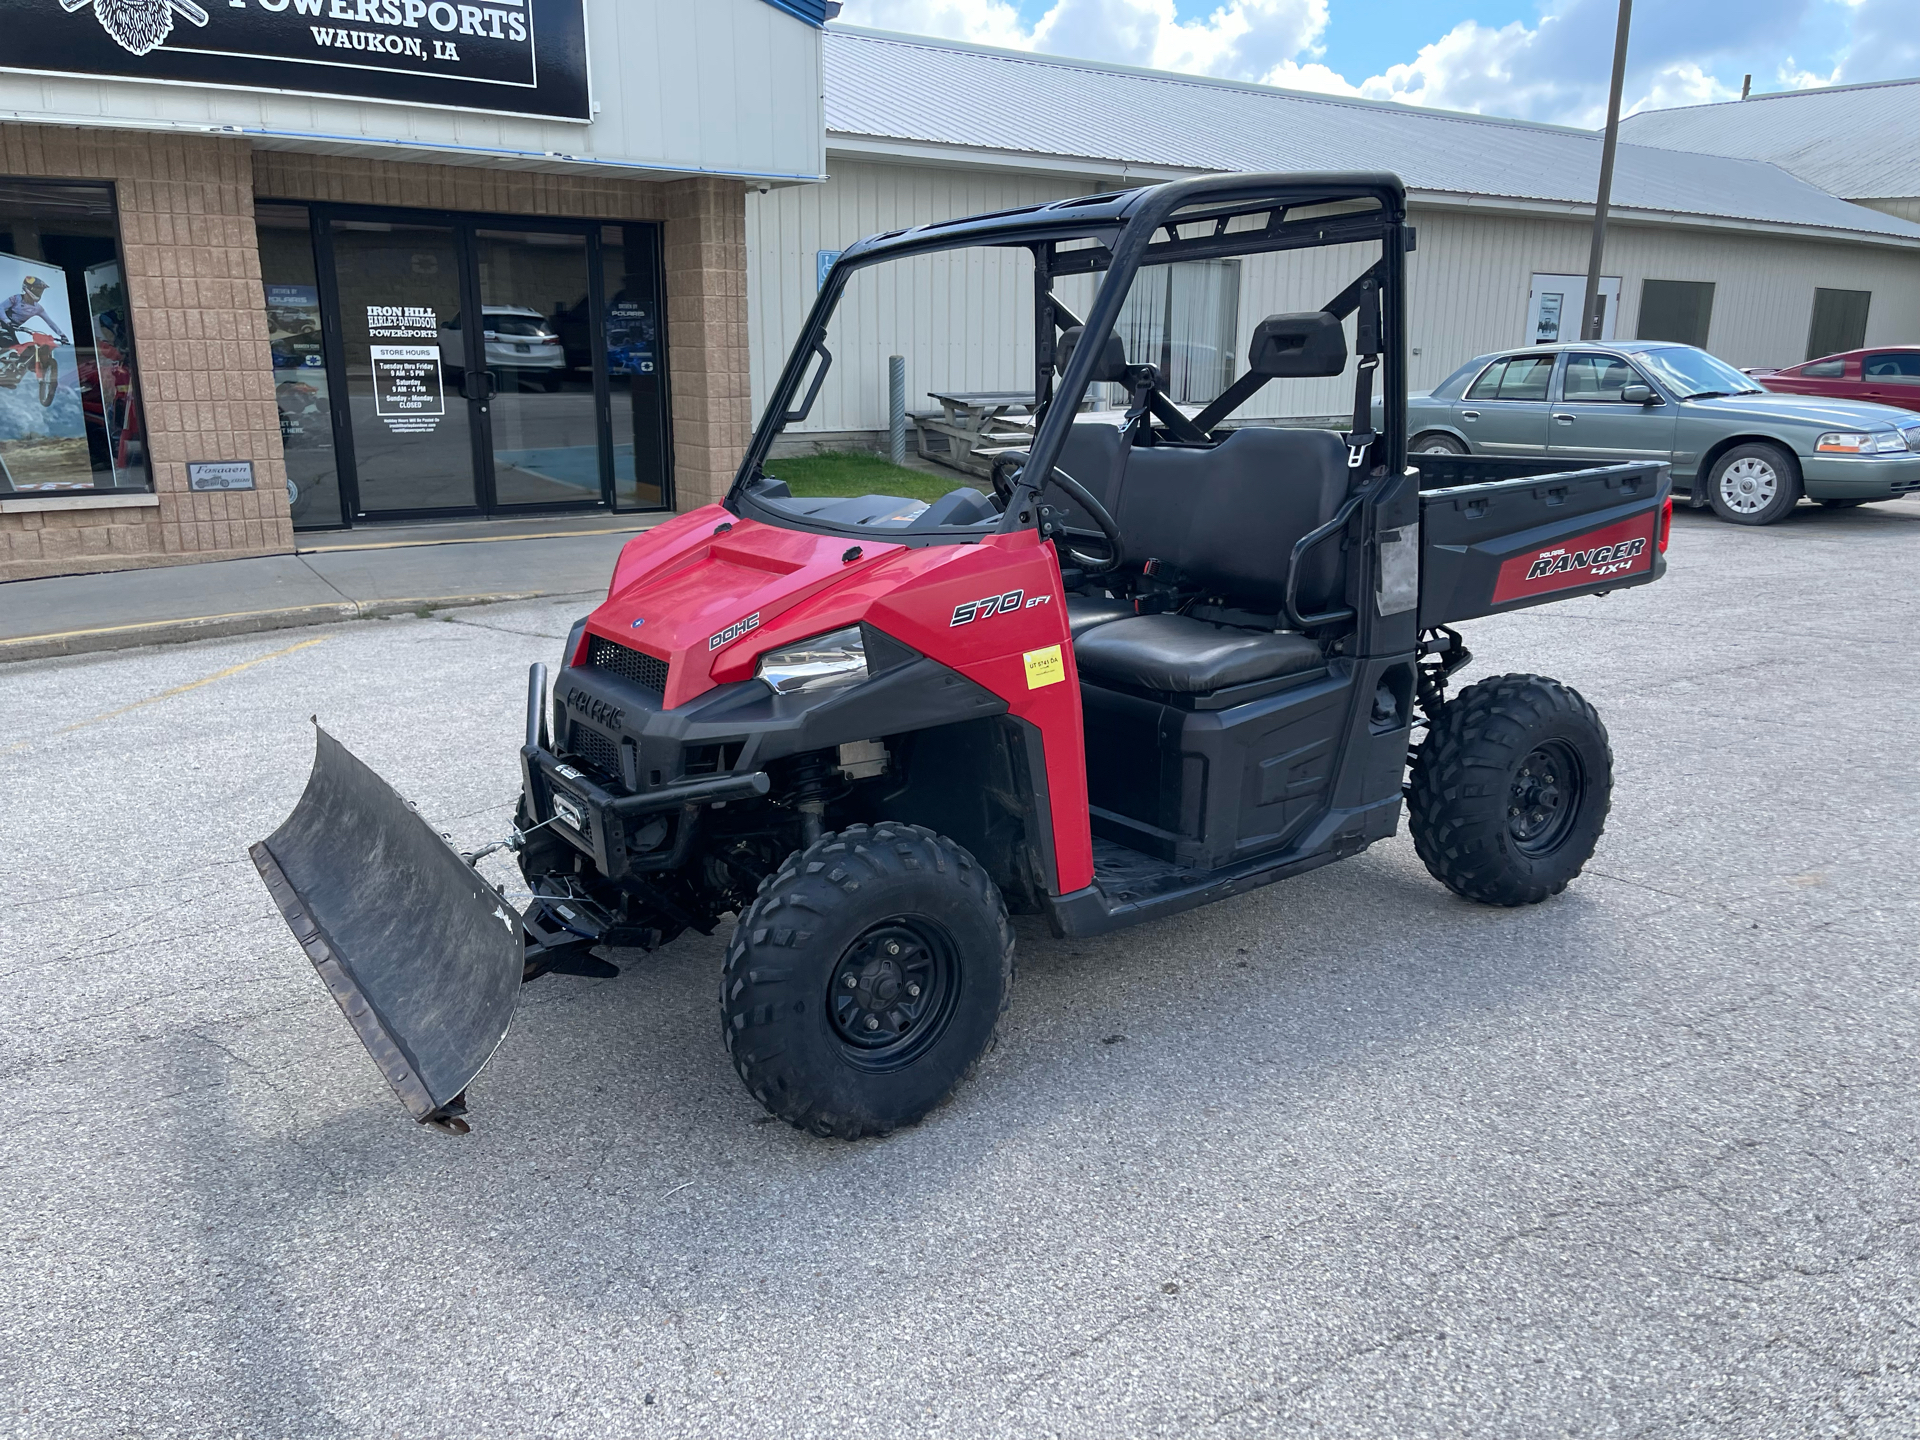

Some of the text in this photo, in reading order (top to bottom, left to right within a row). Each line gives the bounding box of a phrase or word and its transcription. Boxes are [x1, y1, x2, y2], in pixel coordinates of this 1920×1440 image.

[228, 0, 527, 41] WERSPORTS
[310, 26, 460, 61] WAUKON, IA
[366, 306, 436, 317] IRON HILL
[367, 316, 436, 329] HARLEY-DAVIDSON
[369, 329, 438, 338] POWERSPORTS
[416, 363, 434, 371] Friday
[1525, 537, 1646, 580] RANGER
[1539, 548, 1566, 559] POLARIS
[949, 589, 1051, 627] 570 EFI
[709, 611, 760, 651] DOHC
[567, 686, 627, 731] POLARIS
